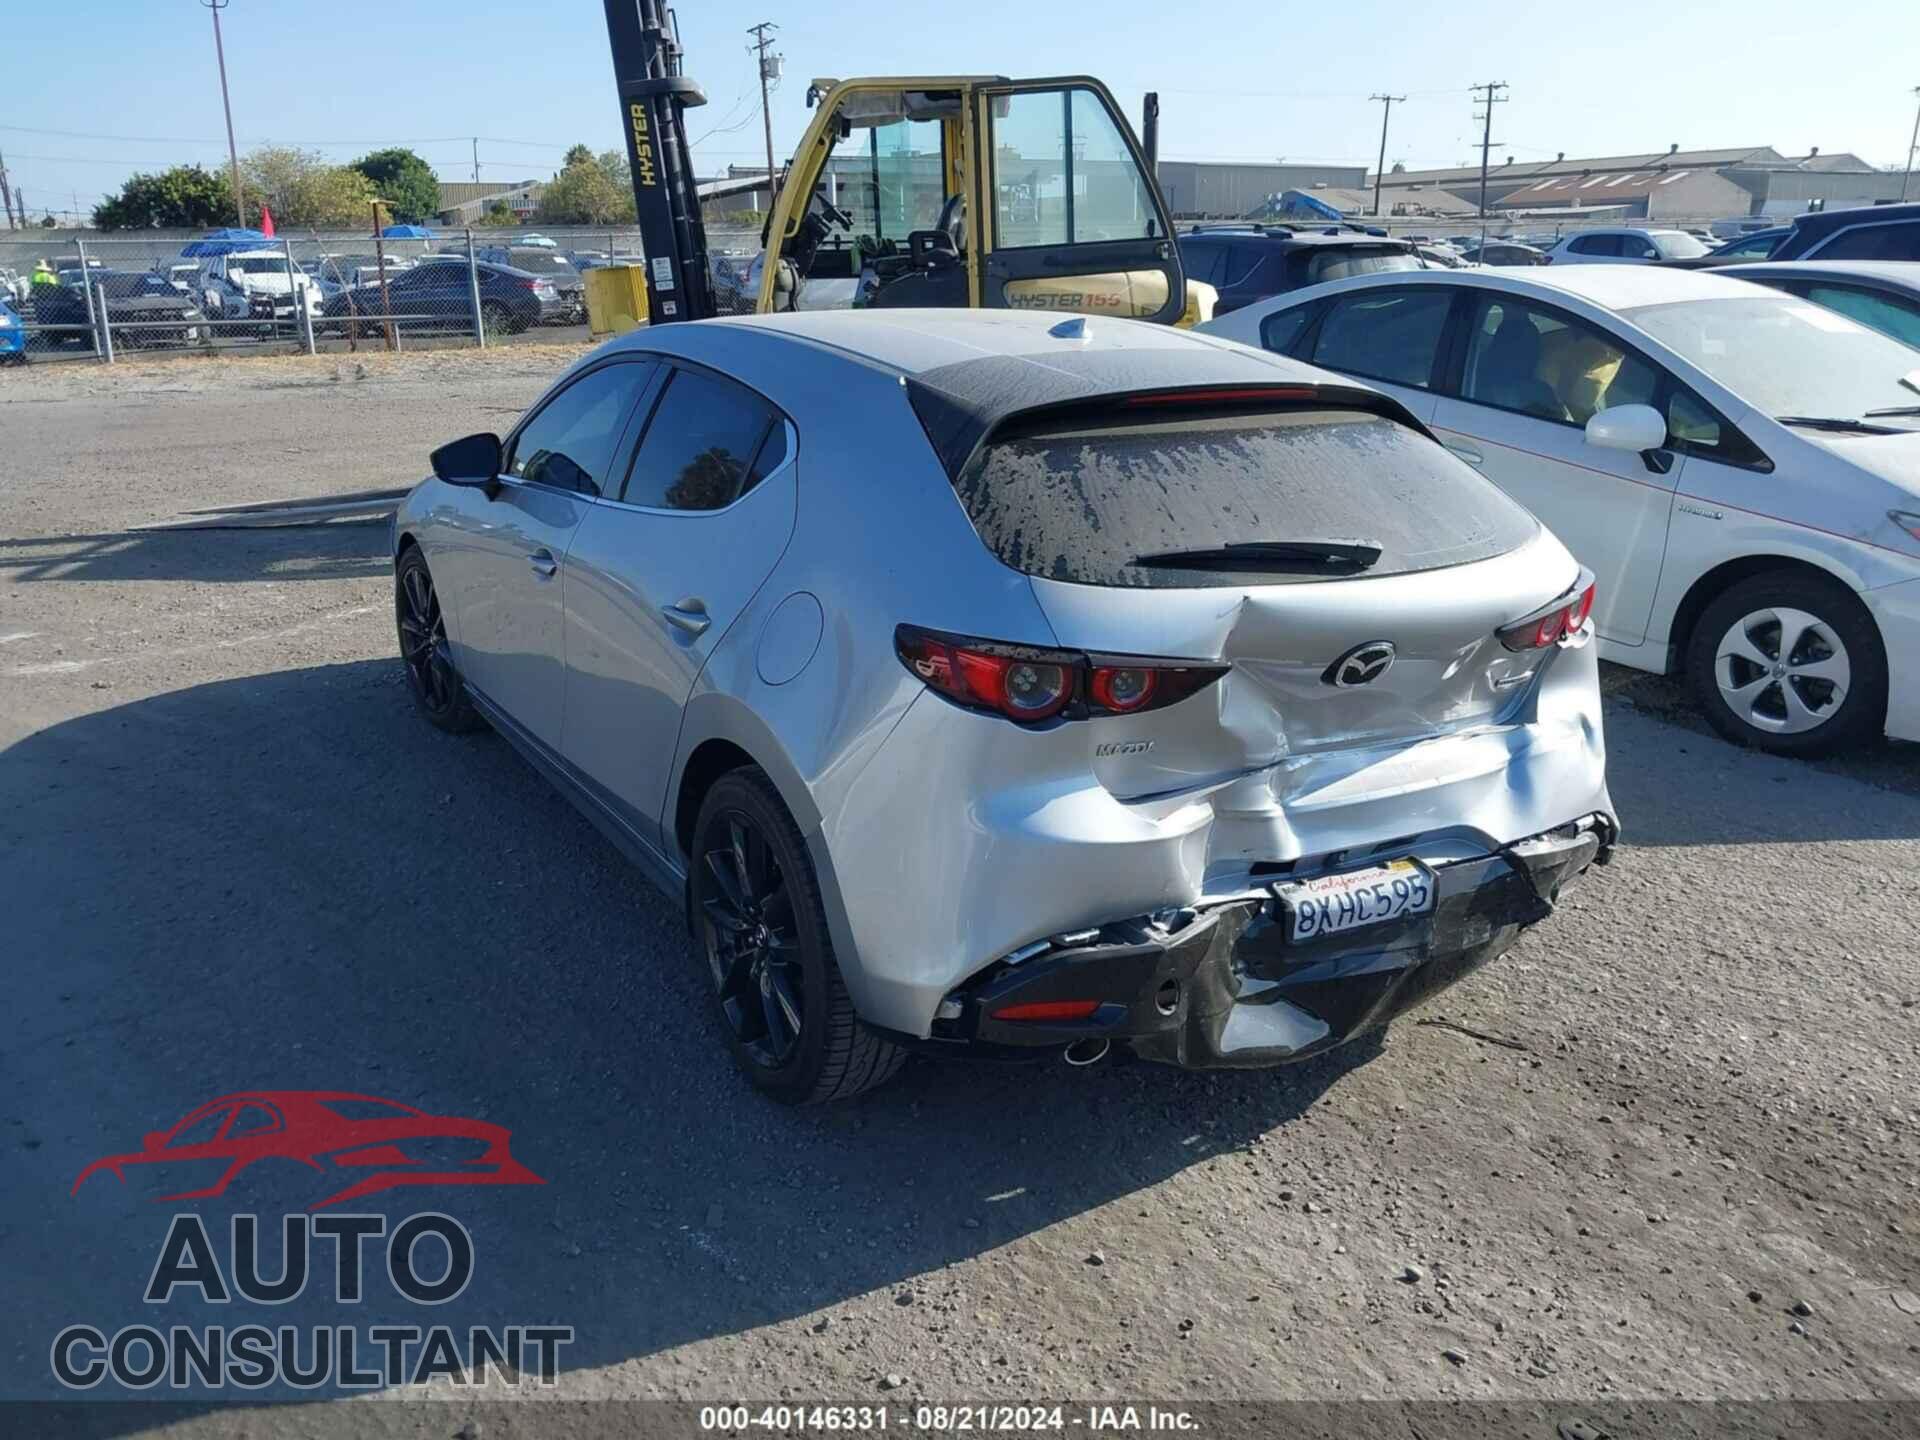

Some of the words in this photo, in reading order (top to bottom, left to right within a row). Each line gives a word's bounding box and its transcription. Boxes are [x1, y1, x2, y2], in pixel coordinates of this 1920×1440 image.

[630, 104, 656, 186] HYSTER
[1011, 293, 1081, 307] HYSTER
[1308, 870, 1387, 893] California
[1297, 874, 1428, 933] 8XHC595
